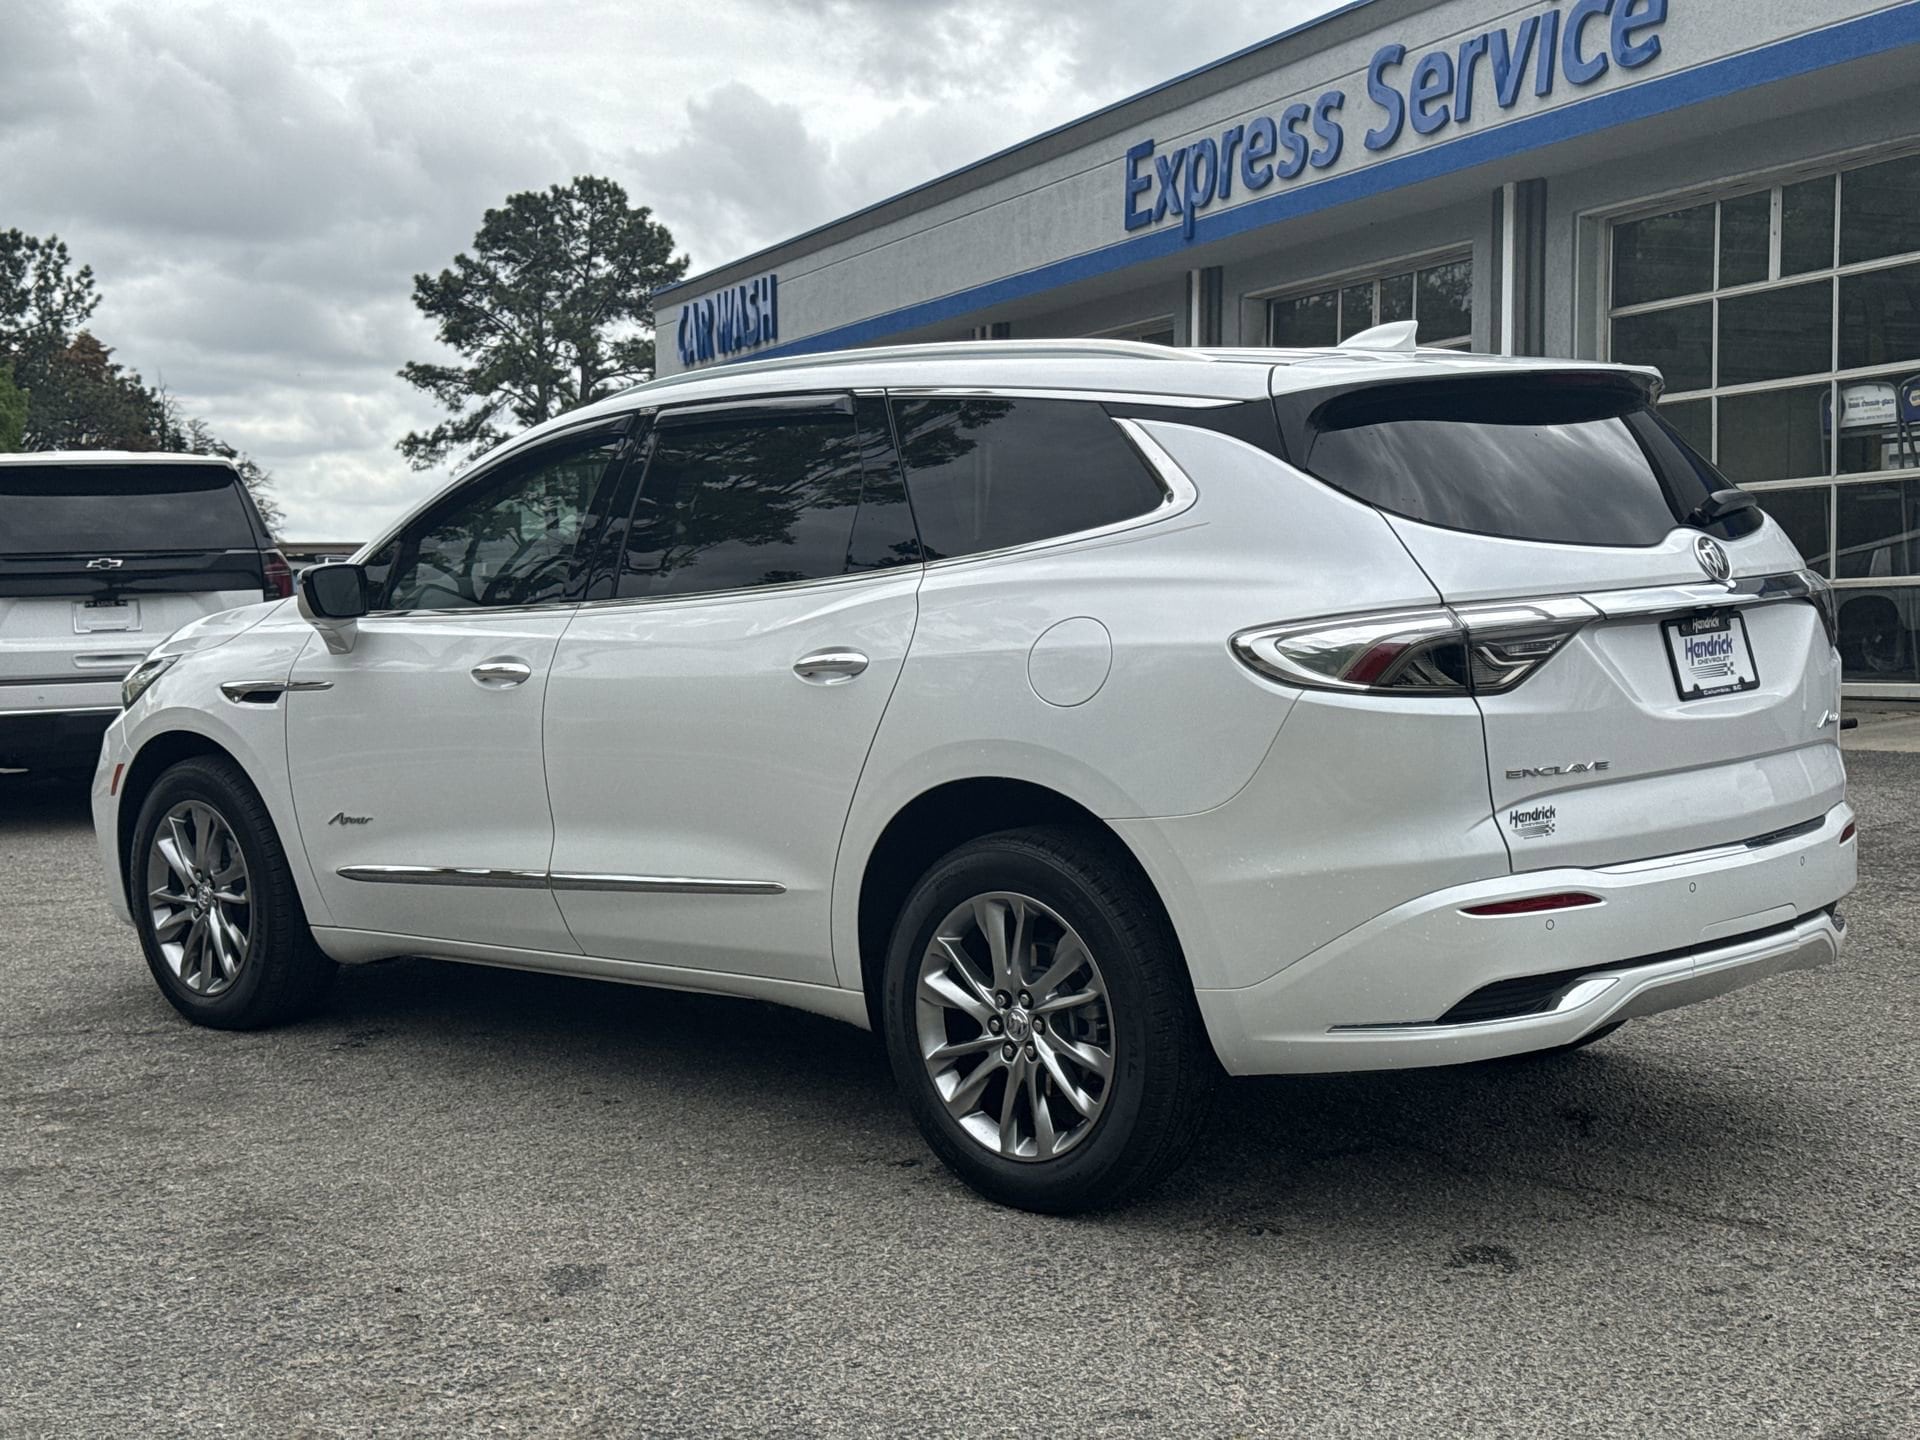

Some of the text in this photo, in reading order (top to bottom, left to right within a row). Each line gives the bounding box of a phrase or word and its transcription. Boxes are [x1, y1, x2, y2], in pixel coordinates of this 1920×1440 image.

[1124, 0, 1669, 240] Express Service
[677, 274, 778, 367] CAR WASH
[1692, 615, 1720, 633] Hendrick
[1684, 632, 1733, 666] Hendrick
[1697, 655, 1730, 665] CHEVROLET
[1505, 761, 1610, 779] ENCLAVE
[1509, 805, 1556, 828] Hendrick
